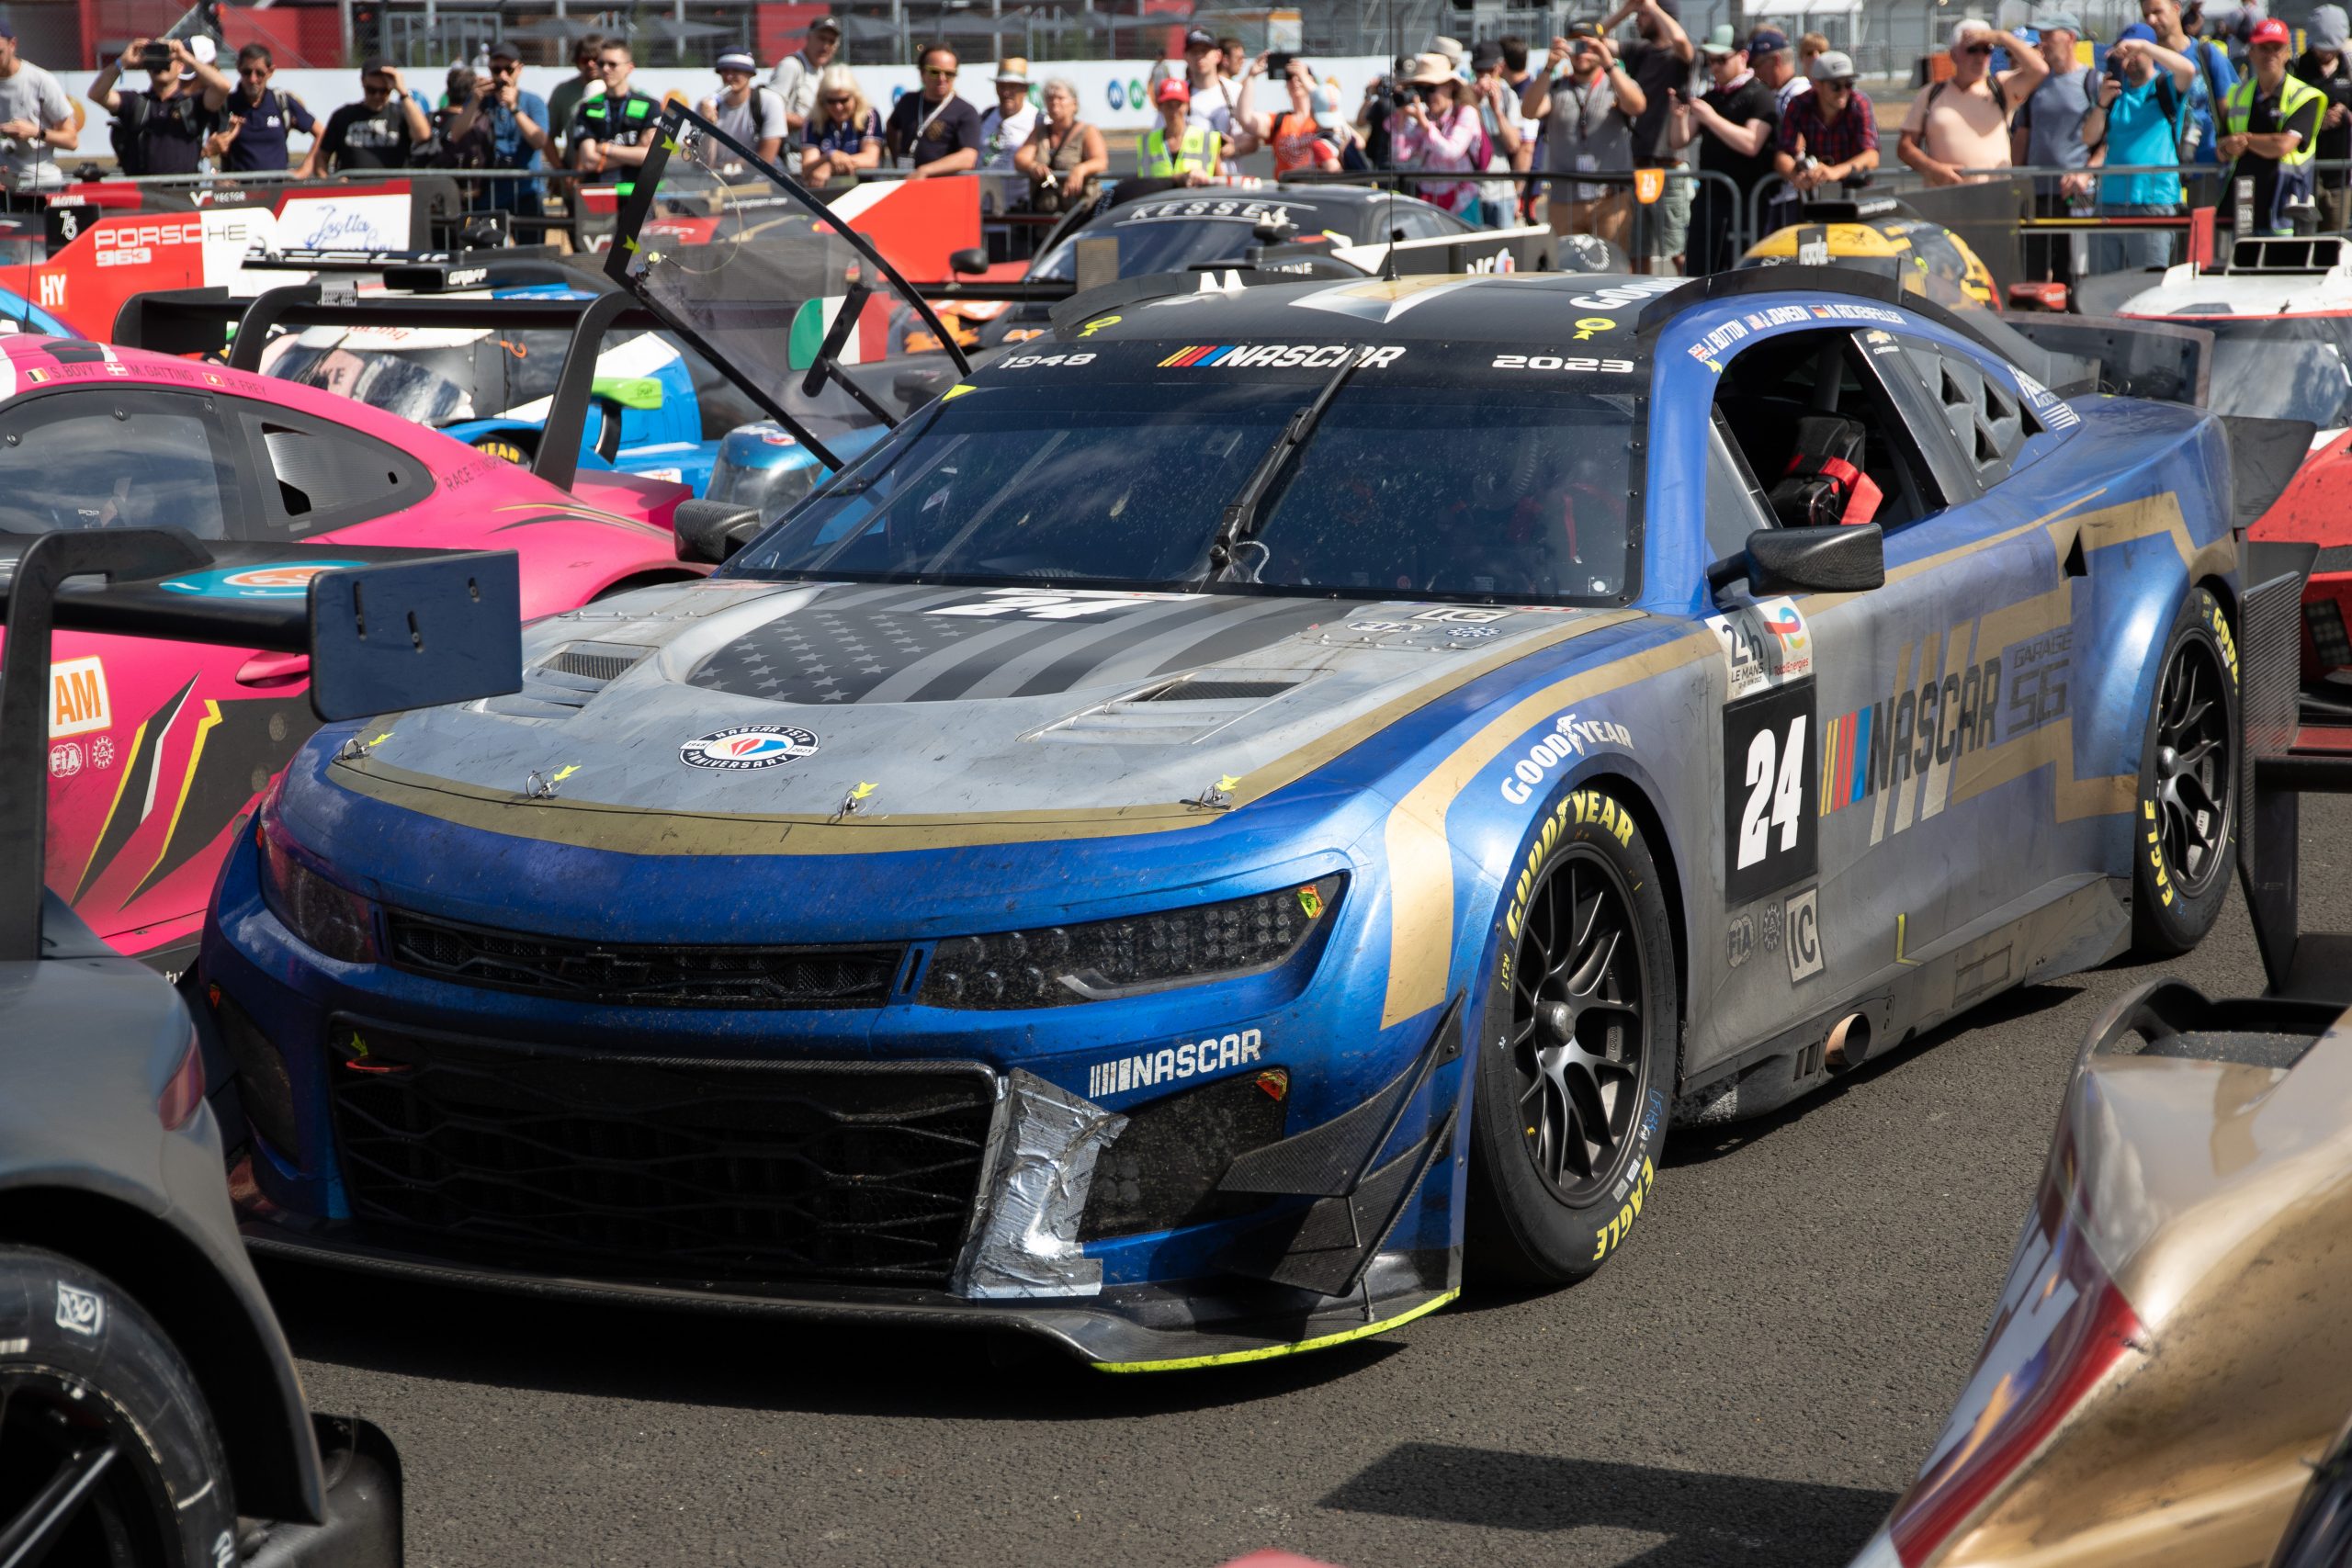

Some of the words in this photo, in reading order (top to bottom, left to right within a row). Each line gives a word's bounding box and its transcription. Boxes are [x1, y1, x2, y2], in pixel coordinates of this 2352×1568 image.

[51, 195, 85, 207] MOTUL
[213, 191, 246, 203] VECTOR
[60, 210, 77, 241] 75
[94, 224, 247, 250] PORSCHE
[96, 247, 153, 267] 963
[40, 274, 67, 307] HY
[1707, 318, 1749, 350] BUTTON
[998, 354, 1097, 369] 1948
[1211, 345, 1407, 368] NASCAR
[1491, 355, 1634, 374] 2023
[66, 366, 95, 378] BOVY
[144, 367, 195, 382] GATTING
[242, 379, 266, 396] FREY
[923, 596, 1156, 619] 24
[2013, 631, 2074, 669] GARAGE
[1731, 669, 1741, 682] LE
[1741, 662, 1764, 679] MANS
[55, 670, 101, 726] AM
[715, 725, 778, 739] NASCAR
[782, 728, 812, 743] 75TH
[1866, 656, 2002, 797] NASCAR
[687, 750, 788, 769] ANNIVERSARY
[1500, 713, 1635, 805] GOODYEAR
[1737, 715, 1807, 871] 24
[1507, 789, 1634, 940] GOODYEAR
[2144, 800, 2174, 908] EAGLE
[1790, 904, 1816, 969] IC
[1132, 1028, 1262, 1089] NASCAR
[1593, 1155, 1654, 1261] EAGLE
